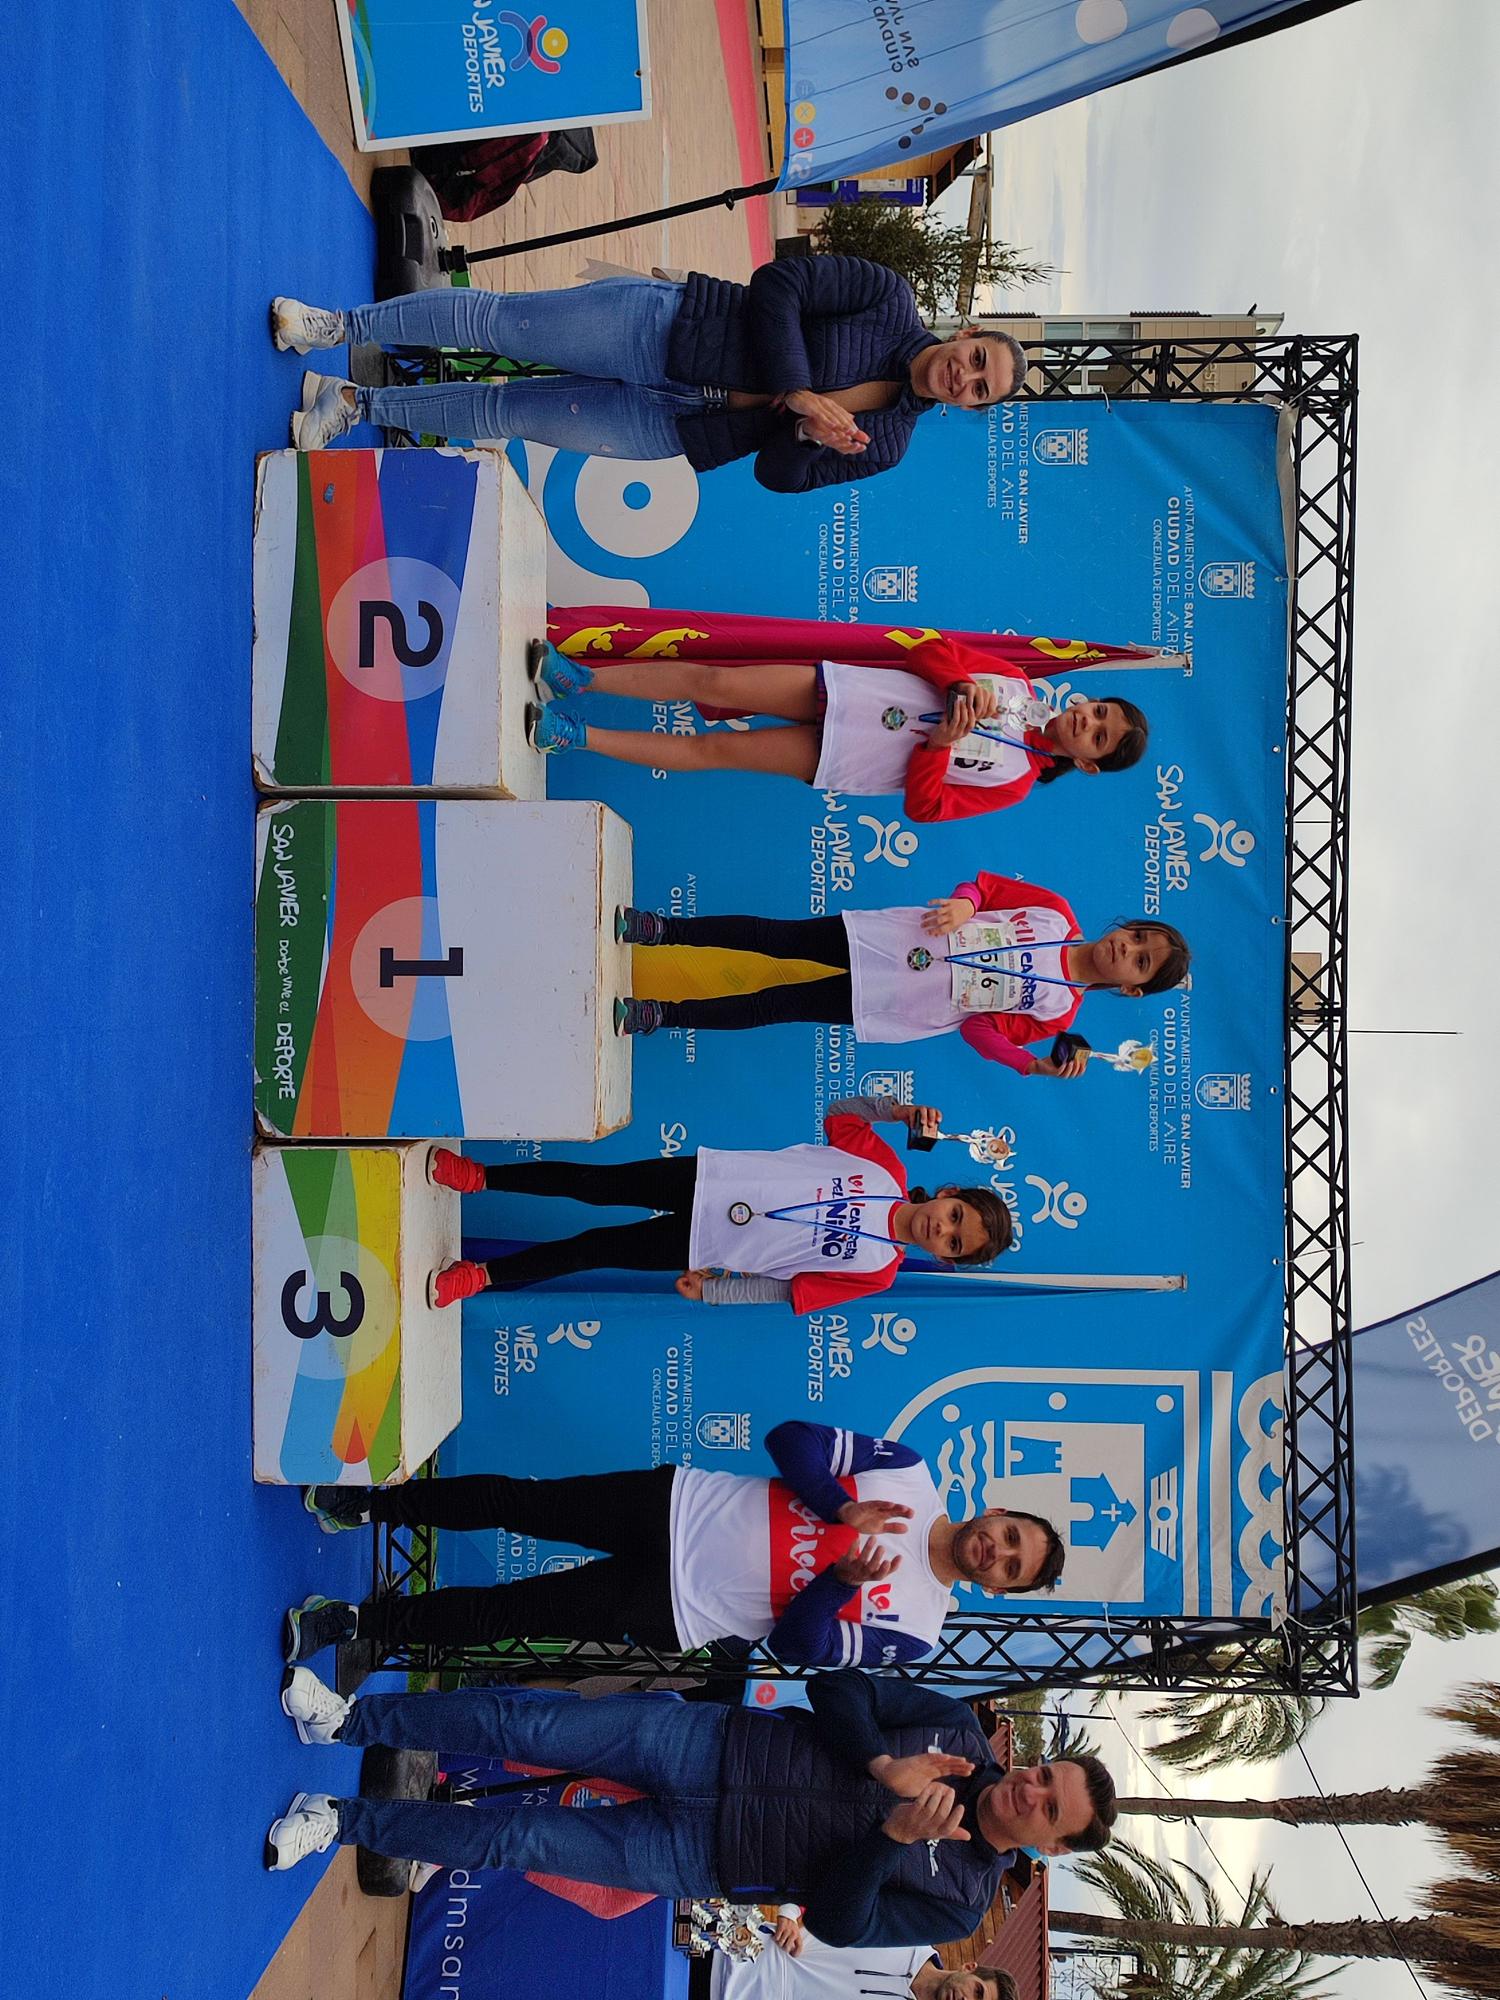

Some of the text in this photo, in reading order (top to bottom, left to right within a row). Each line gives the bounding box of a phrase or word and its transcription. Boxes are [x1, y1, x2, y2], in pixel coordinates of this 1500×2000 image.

[461, 24, 484, 113] DEPORTES
[472, 11, 506, 88] JAVIER
[987, 405, 999, 508] CEJALÍA DE DEPORTES
[1001, 402, 1014, 520] DAD DEL AIRE
[1017, 402, 1029, 544] MIENTO DE SAN JAVIER
[832, 502, 845, 570] CIUDAD
[849, 488, 860, 623] AYUNTAMIENTO DE SA
[1167, 496, 1180, 566] CIUDAD
[1183, 486, 1195, 578] AYUNTAMIENTO
[817, 524, 829, 622] CONCEJALÍA DE DEPO
[832, 576, 845, 607] DEL
[1151, 518, 1164, 641] CONCEJALÍA DE DEPORTES
[1167, 572, 1180, 604] DEL
[1183, 582, 1195, 599] DE
[359, 600, 443, 669] 2
[1182, 602, 1194, 629] SAN
[669, 700, 697, 736] AVIE
[272, 824, 294, 860] SAN
[822, 789, 855, 892] AN JAVIER
[1156, 764, 1191, 892] SAN JAVIER
[275, 863, 300, 927] JAVIER
[671, 887, 682, 916] CIU
[810, 826, 826, 915] DEPORTES
[1143, 824, 1161, 915] DEPORTES
[379, 946, 463, 989] 1
[686, 873, 696, 1063] AYUNTA AVIER
[272, 1023, 295, 1100] DEPORTE
[815, 1027, 825, 1083] CONCEJALÍA
[815, 1085, 823, 1098] DE
[829, 1024, 841, 1100] UDAD DE
[845, 1026, 855, 1087] TAMIENTO
[1148, 1029, 1161, 1152] CONCJALÍA DE DEPORTES
[1163, 1007, 1176, 1165] CIUDAD DEL AIRE
[1180, 993, 1192, 1189] AYUNTAMIENTO DE SAN JAVIER
[831, 1177, 843, 1199] DEL
[282, 1269, 364, 1338] 3
[494, 1326, 509, 1396] PORTES
[514, 1326, 538, 1373] VIER
[808, 1316, 824, 1402] DEPORTES
[826, 1315, 853, 1378] AVIER
[651, 1368, 662, 1468] CONCEJALÍA DE DEPO
[666, 1347, 678, 1453] CIUDAD DEL
[682, 1333, 692, 1470] AYUNTAMIENTO DE SA
[496, 1528, 506, 1568] CEJALÍA
